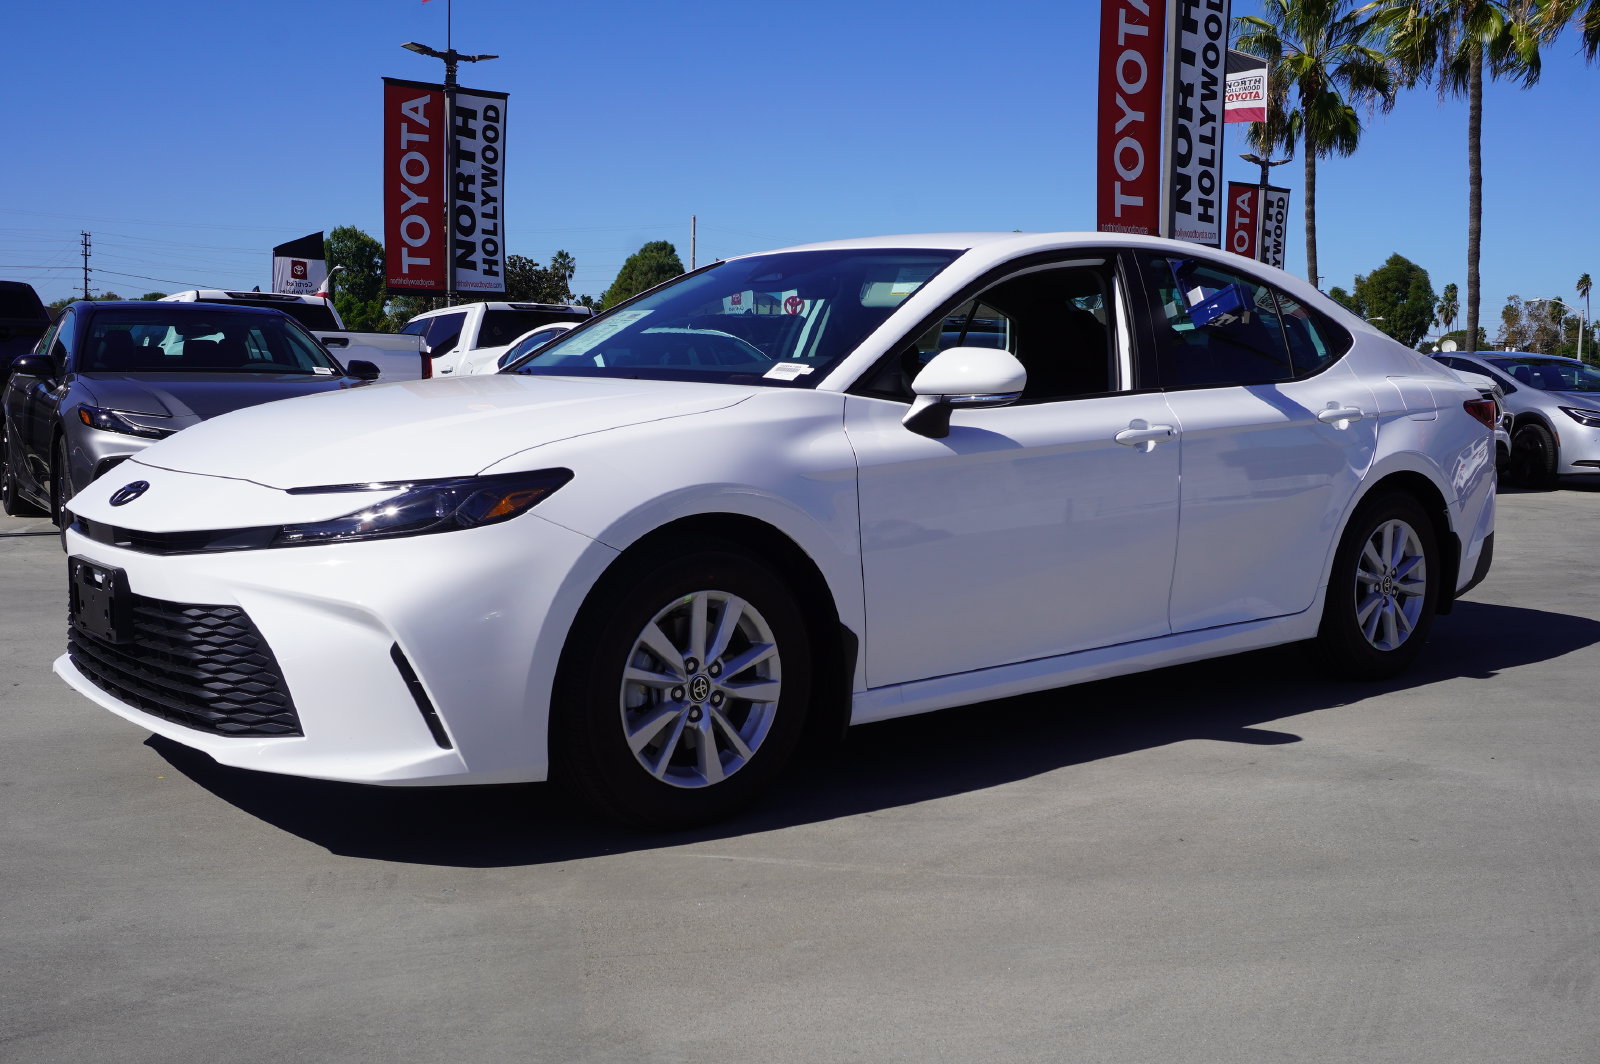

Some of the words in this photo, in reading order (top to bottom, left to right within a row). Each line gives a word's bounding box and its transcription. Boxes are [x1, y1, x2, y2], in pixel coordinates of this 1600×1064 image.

[1226, 78, 1261, 88] NORTH
[1226, 85, 1260, 93] OLLYWOOD
[399, 94, 431, 274] TOYOTA
[455, 105, 477, 271] NORTH
[480, 104, 500, 277] HOLLYWOOD
[1175, 228, 1216, 240] hollywoodtoyota.com
[1233, 191, 1252, 253] OTA
[1272, 196, 1286, 269] YWOOD
[456, 279, 503, 289] rthhollywoodtoyota.com
